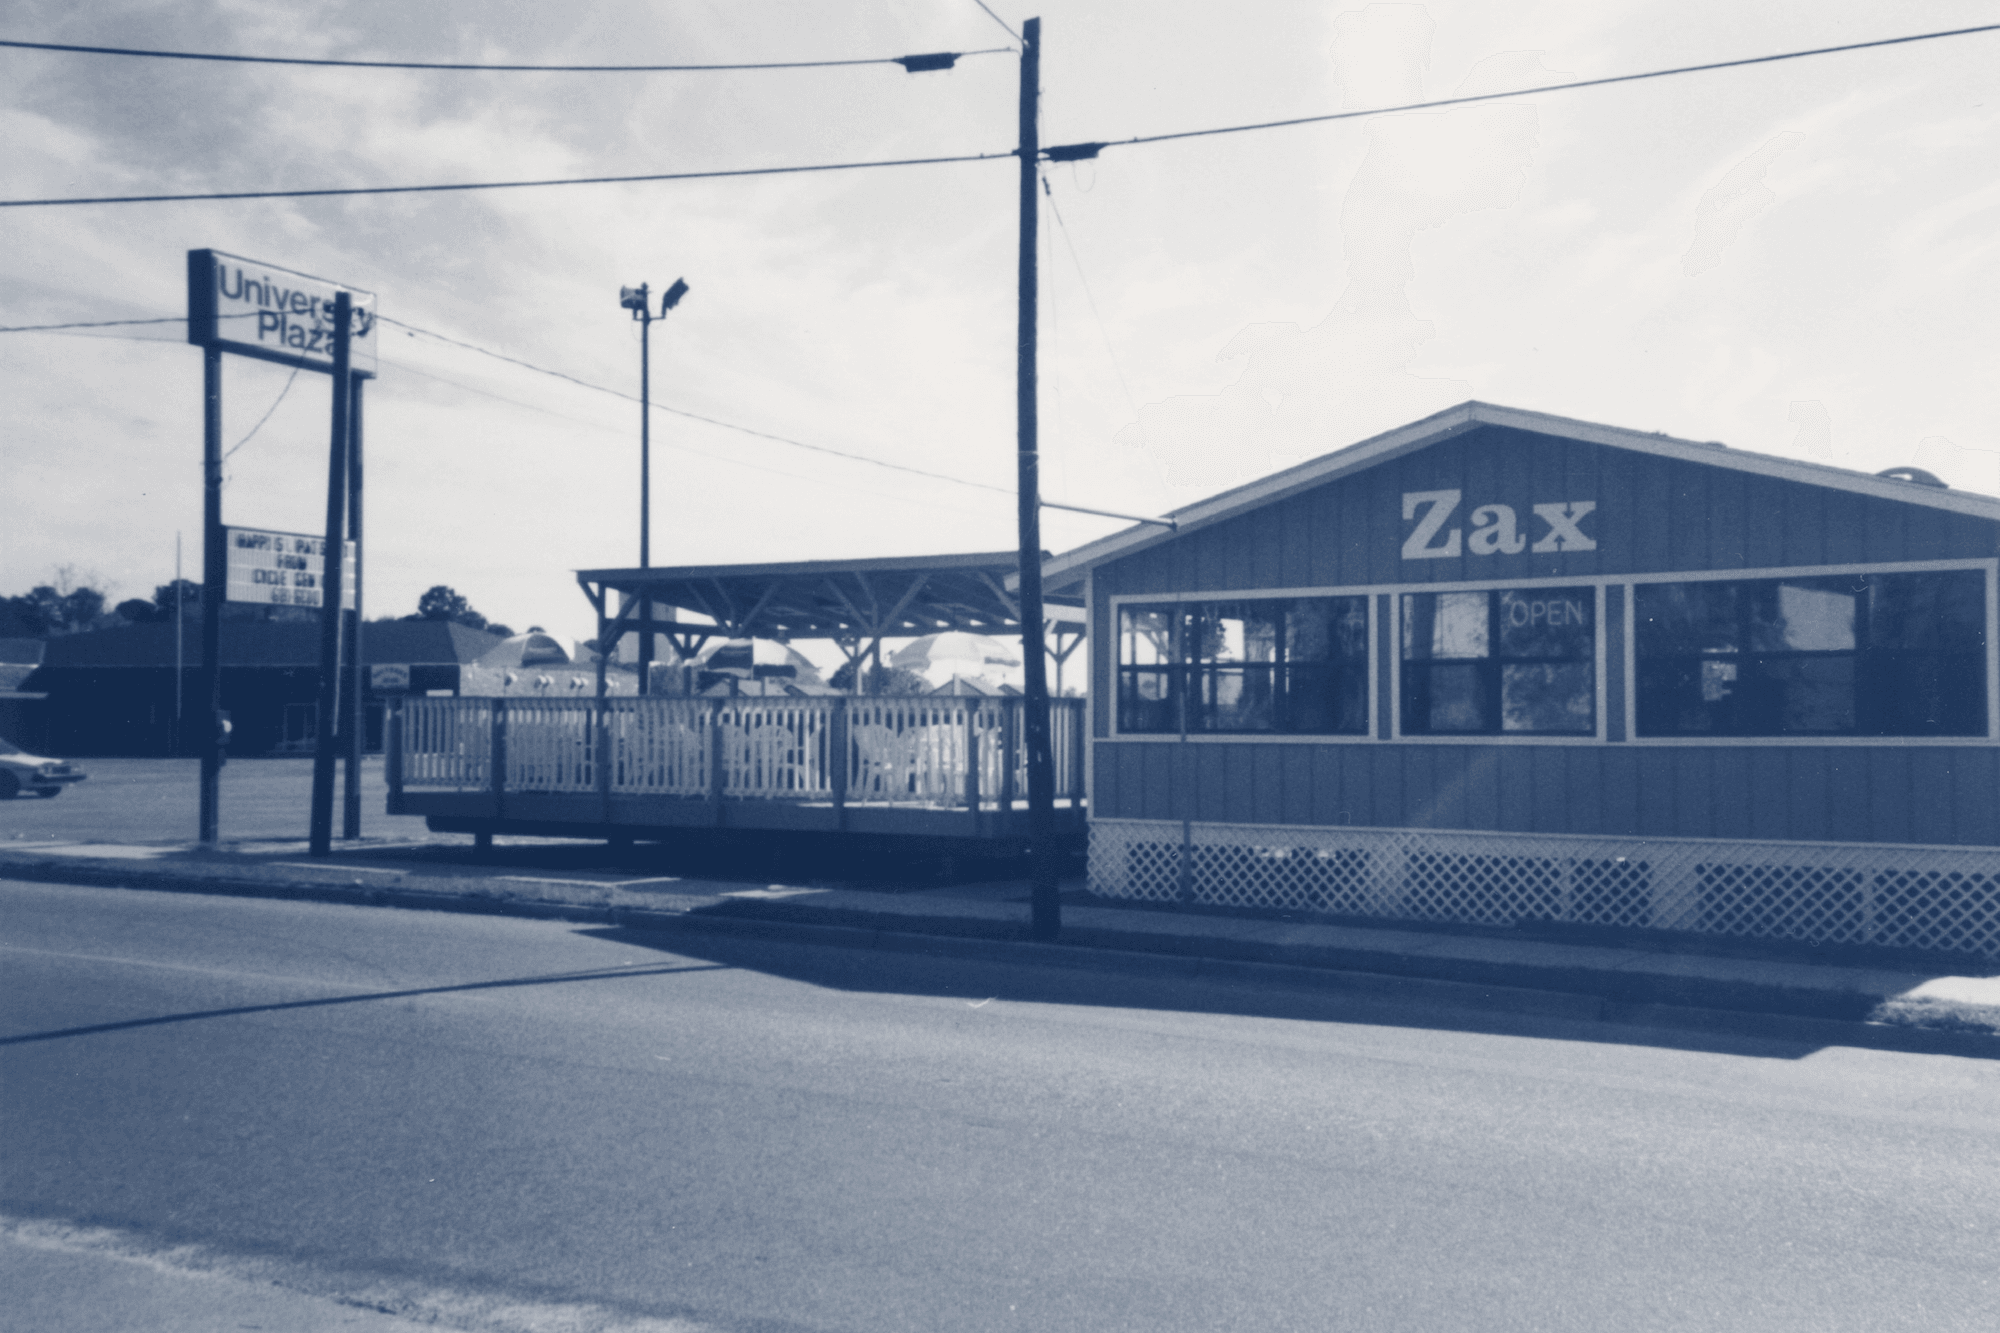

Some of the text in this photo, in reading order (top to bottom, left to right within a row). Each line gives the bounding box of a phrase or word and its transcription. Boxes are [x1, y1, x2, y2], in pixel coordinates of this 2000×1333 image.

[220, 264, 373, 338] Universy
[1401, 489, 1597, 560] Zax
[1510, 599, 1583, 627] OPEN
